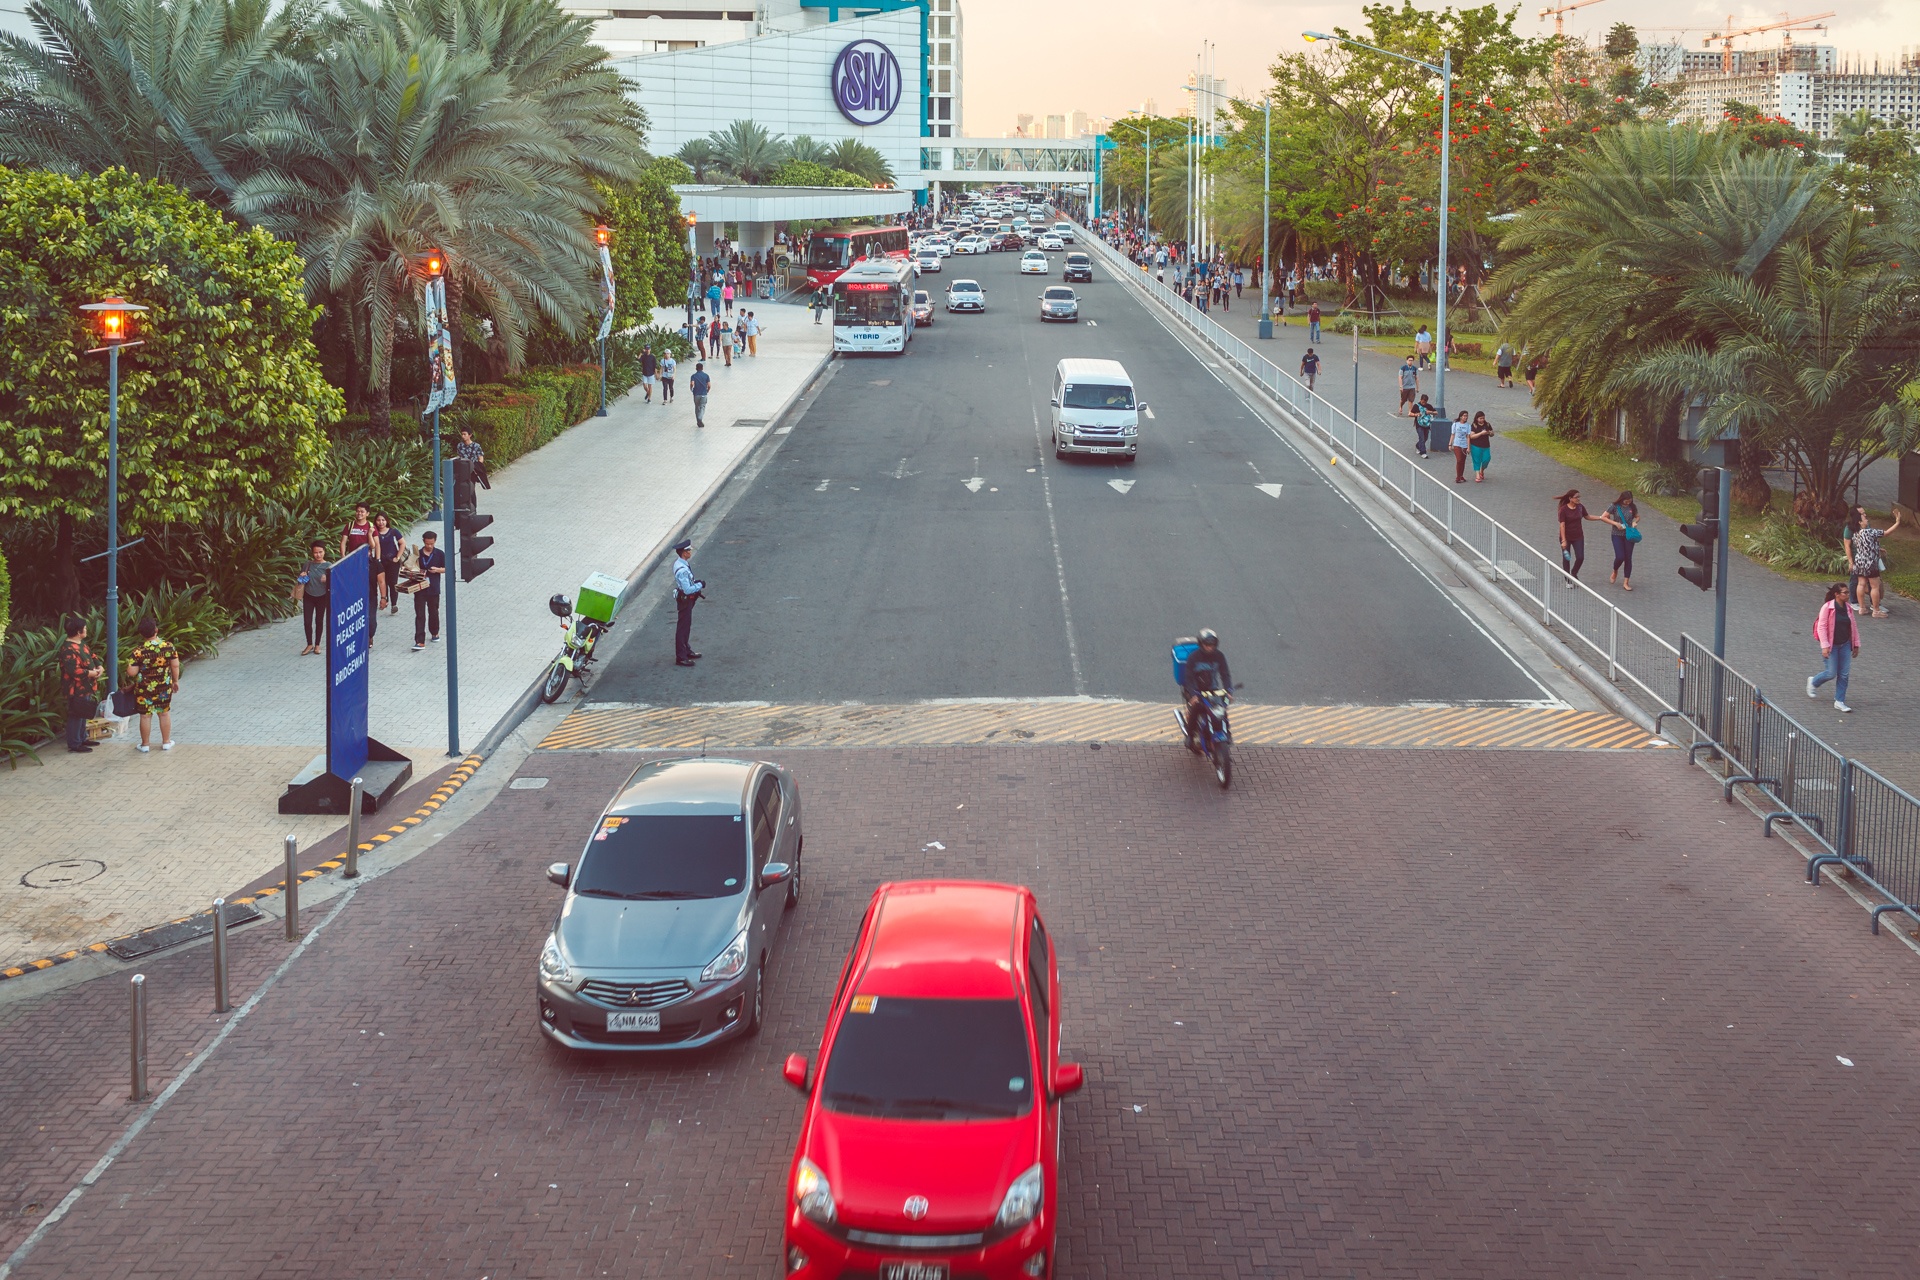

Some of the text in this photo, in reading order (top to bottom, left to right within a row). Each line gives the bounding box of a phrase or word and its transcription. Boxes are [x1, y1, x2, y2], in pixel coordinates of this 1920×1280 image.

[841, 50, 890, 111] SM
[337, 598, 364, 627] TO CROSS
[336, 615, 366, 648] PLEASE USE
[345, 640, 356, 658] THE
[335, 650, 367, 687] BRIDGEWAY
[638, 1015, 659, 1027] 6483
